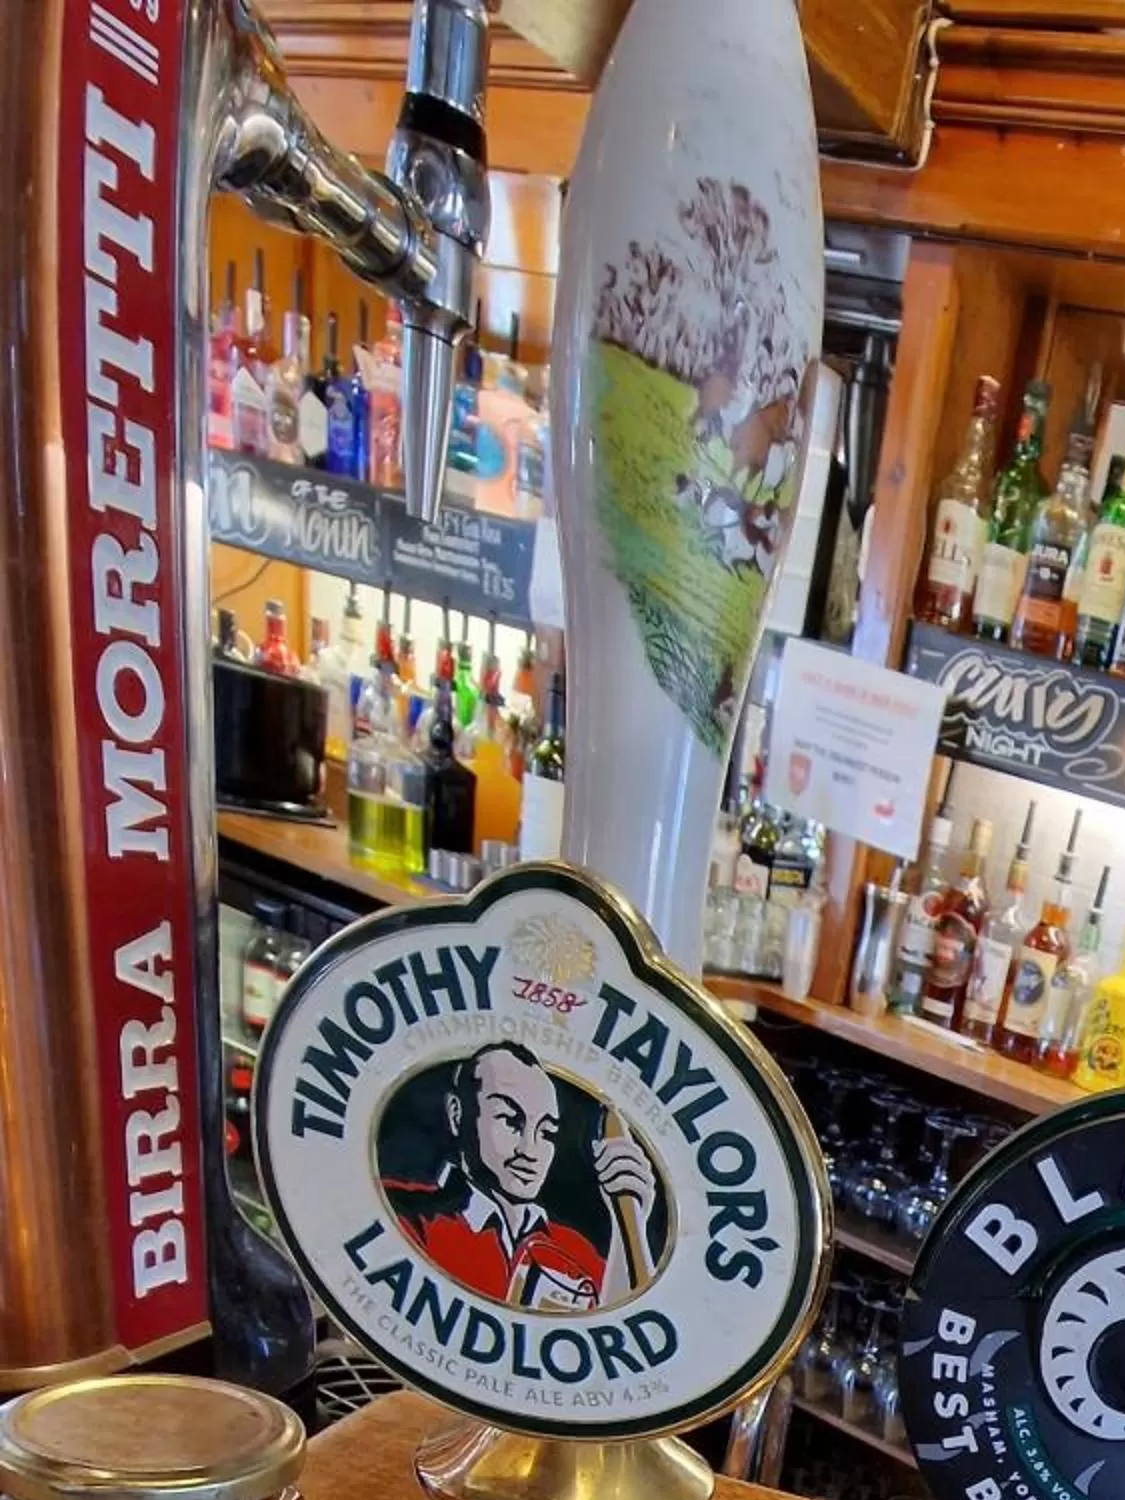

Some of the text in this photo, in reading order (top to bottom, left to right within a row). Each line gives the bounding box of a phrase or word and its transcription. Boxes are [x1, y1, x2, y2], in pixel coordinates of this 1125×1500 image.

[82, 80, 170, 861] MORETTI
[966, 725, 1046, 766] NIGHT
[513, 976, 588, 1013] 1858
[112, 920, 188, 1299] BIRRA
[293, 945, 784, 1290] TIMOTHY TAYLOR'S
[403, 1013, 676, 1136] CHAMPIONSHIP BEERS
[342, 1275, 373, 1315] THE
[378, 1314, 458, 1378] CLASSIC
[464, 1367, 515, 1398] PALE
[524, 1387, 565, 1408] ALE
[571, 1389, 615, 1408] ABV
[344, 1220, 678, 1385] LANDLORD
[930, 1307, 980, 1456] BEST
